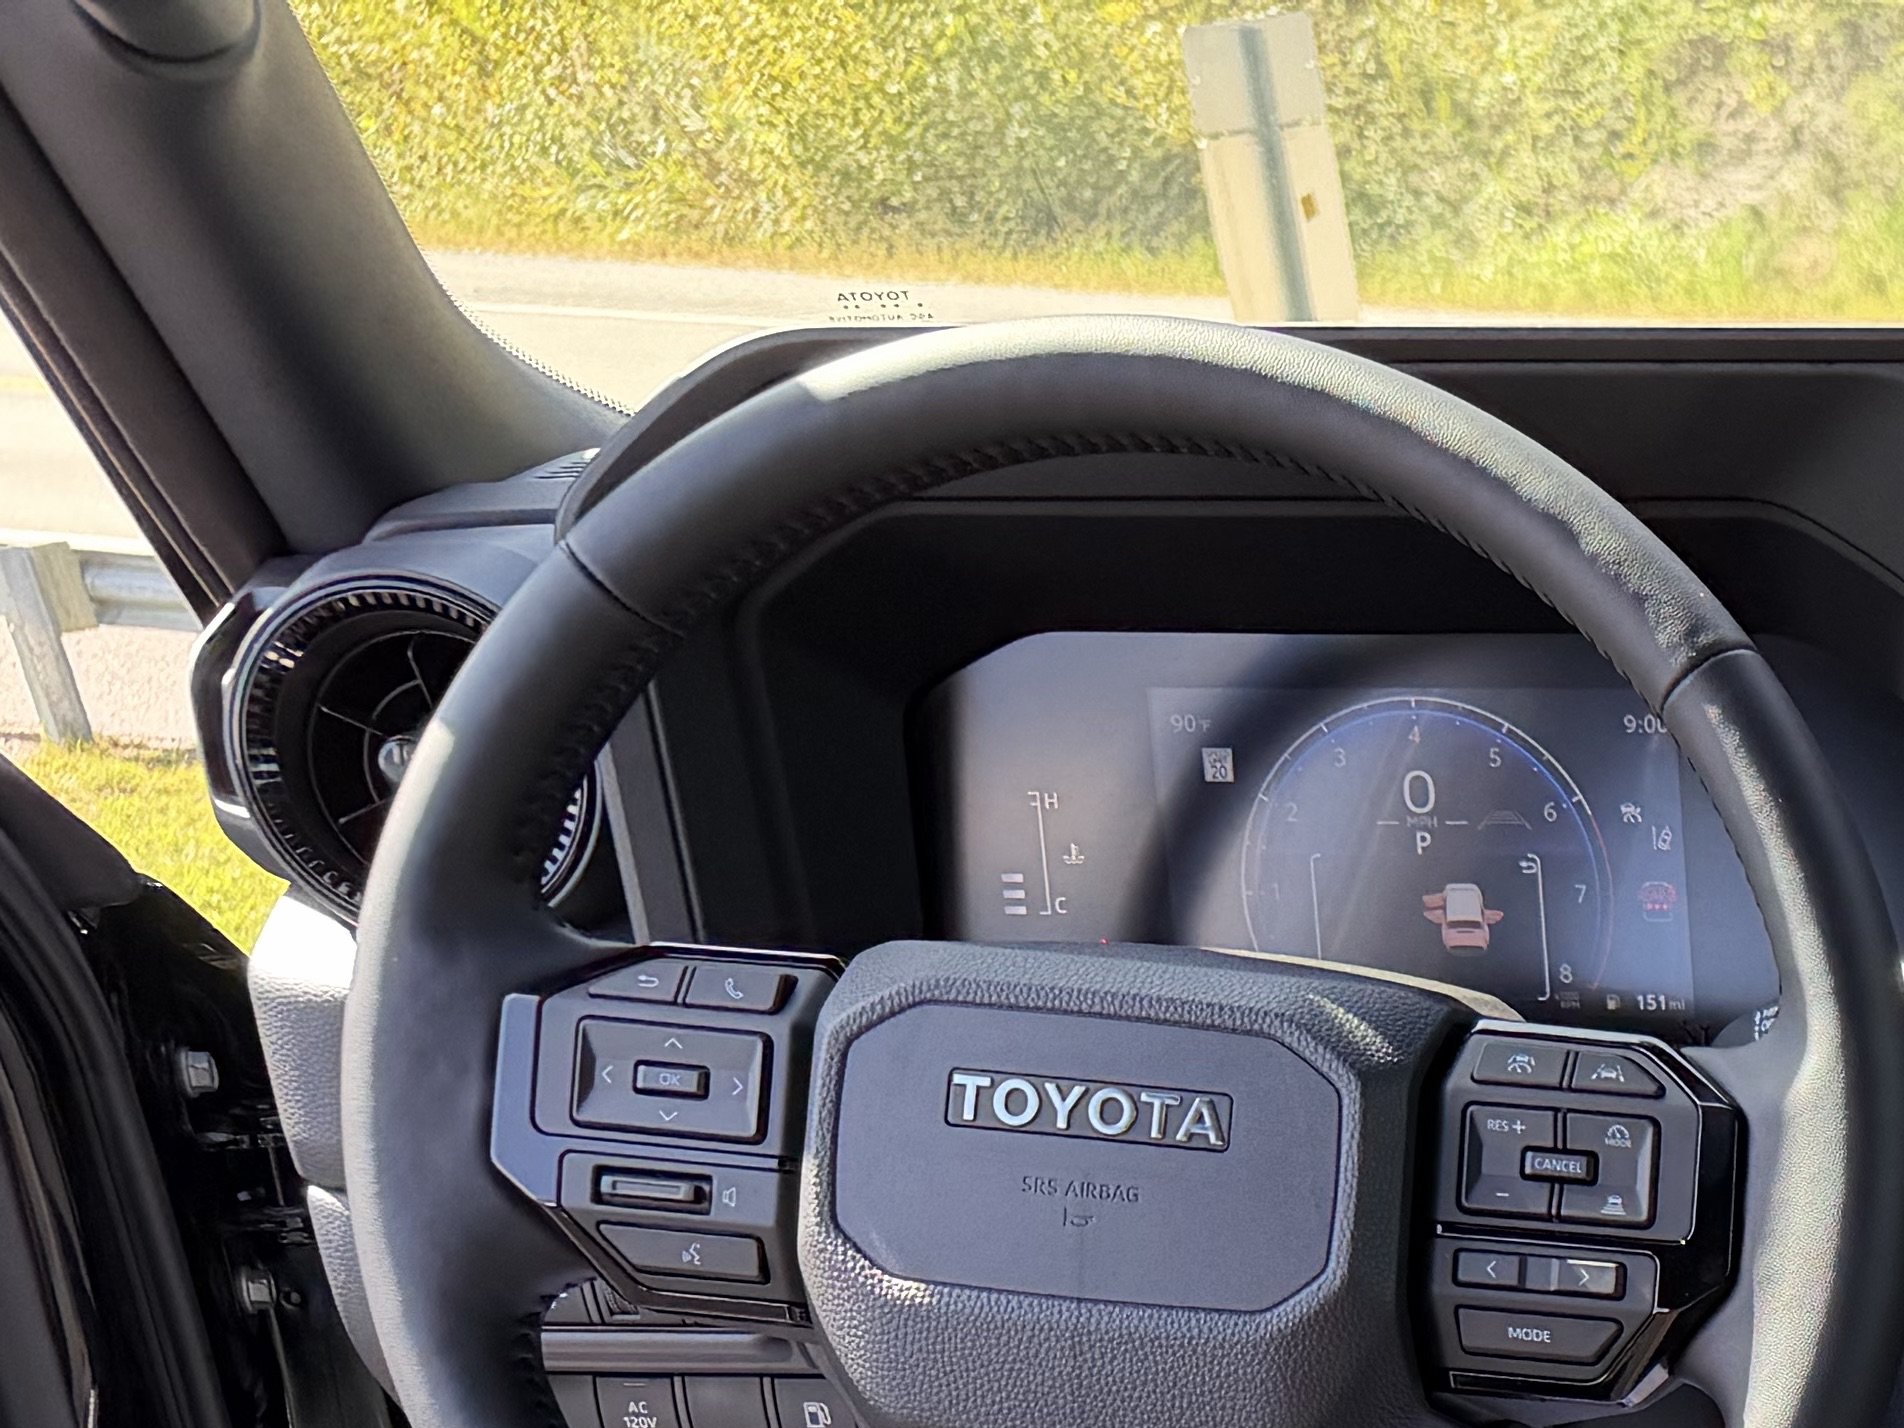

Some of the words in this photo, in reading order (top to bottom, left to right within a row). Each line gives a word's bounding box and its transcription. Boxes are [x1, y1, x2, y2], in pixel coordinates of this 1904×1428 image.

[1408, 726, 1421, 744] 4
[1334, 748, 1347, 768] 3
[1489, 747, 1502, 768] 5
[1044, 792, 1058, 809] H
[1285, 803, 1298, 822] 2
[1543, 801, 1557, 822] 6
[1406, 815, 1438, 828] MPH
[1415, 830, 1432, 855] P
[1574, 884, 1587, 904] 7
[1055, 897, 1068, 914] C
[1559, 963, 1573, 984] 8
[658, 1073, 681, 1086] OK
[951, 1072, 1227, 1146] TOYOTA
[1534, 1157, 1582, 1174] CANCEL
[1021, 1175, 1058, 1196] SRS
[1064, 1180, 1141, 1203] AIRBAG
[1507, 1326, 1552, 1343] MODE
[628, 1401, 648, 1414] AC
[623, 1416, 657, 1428] 120V
